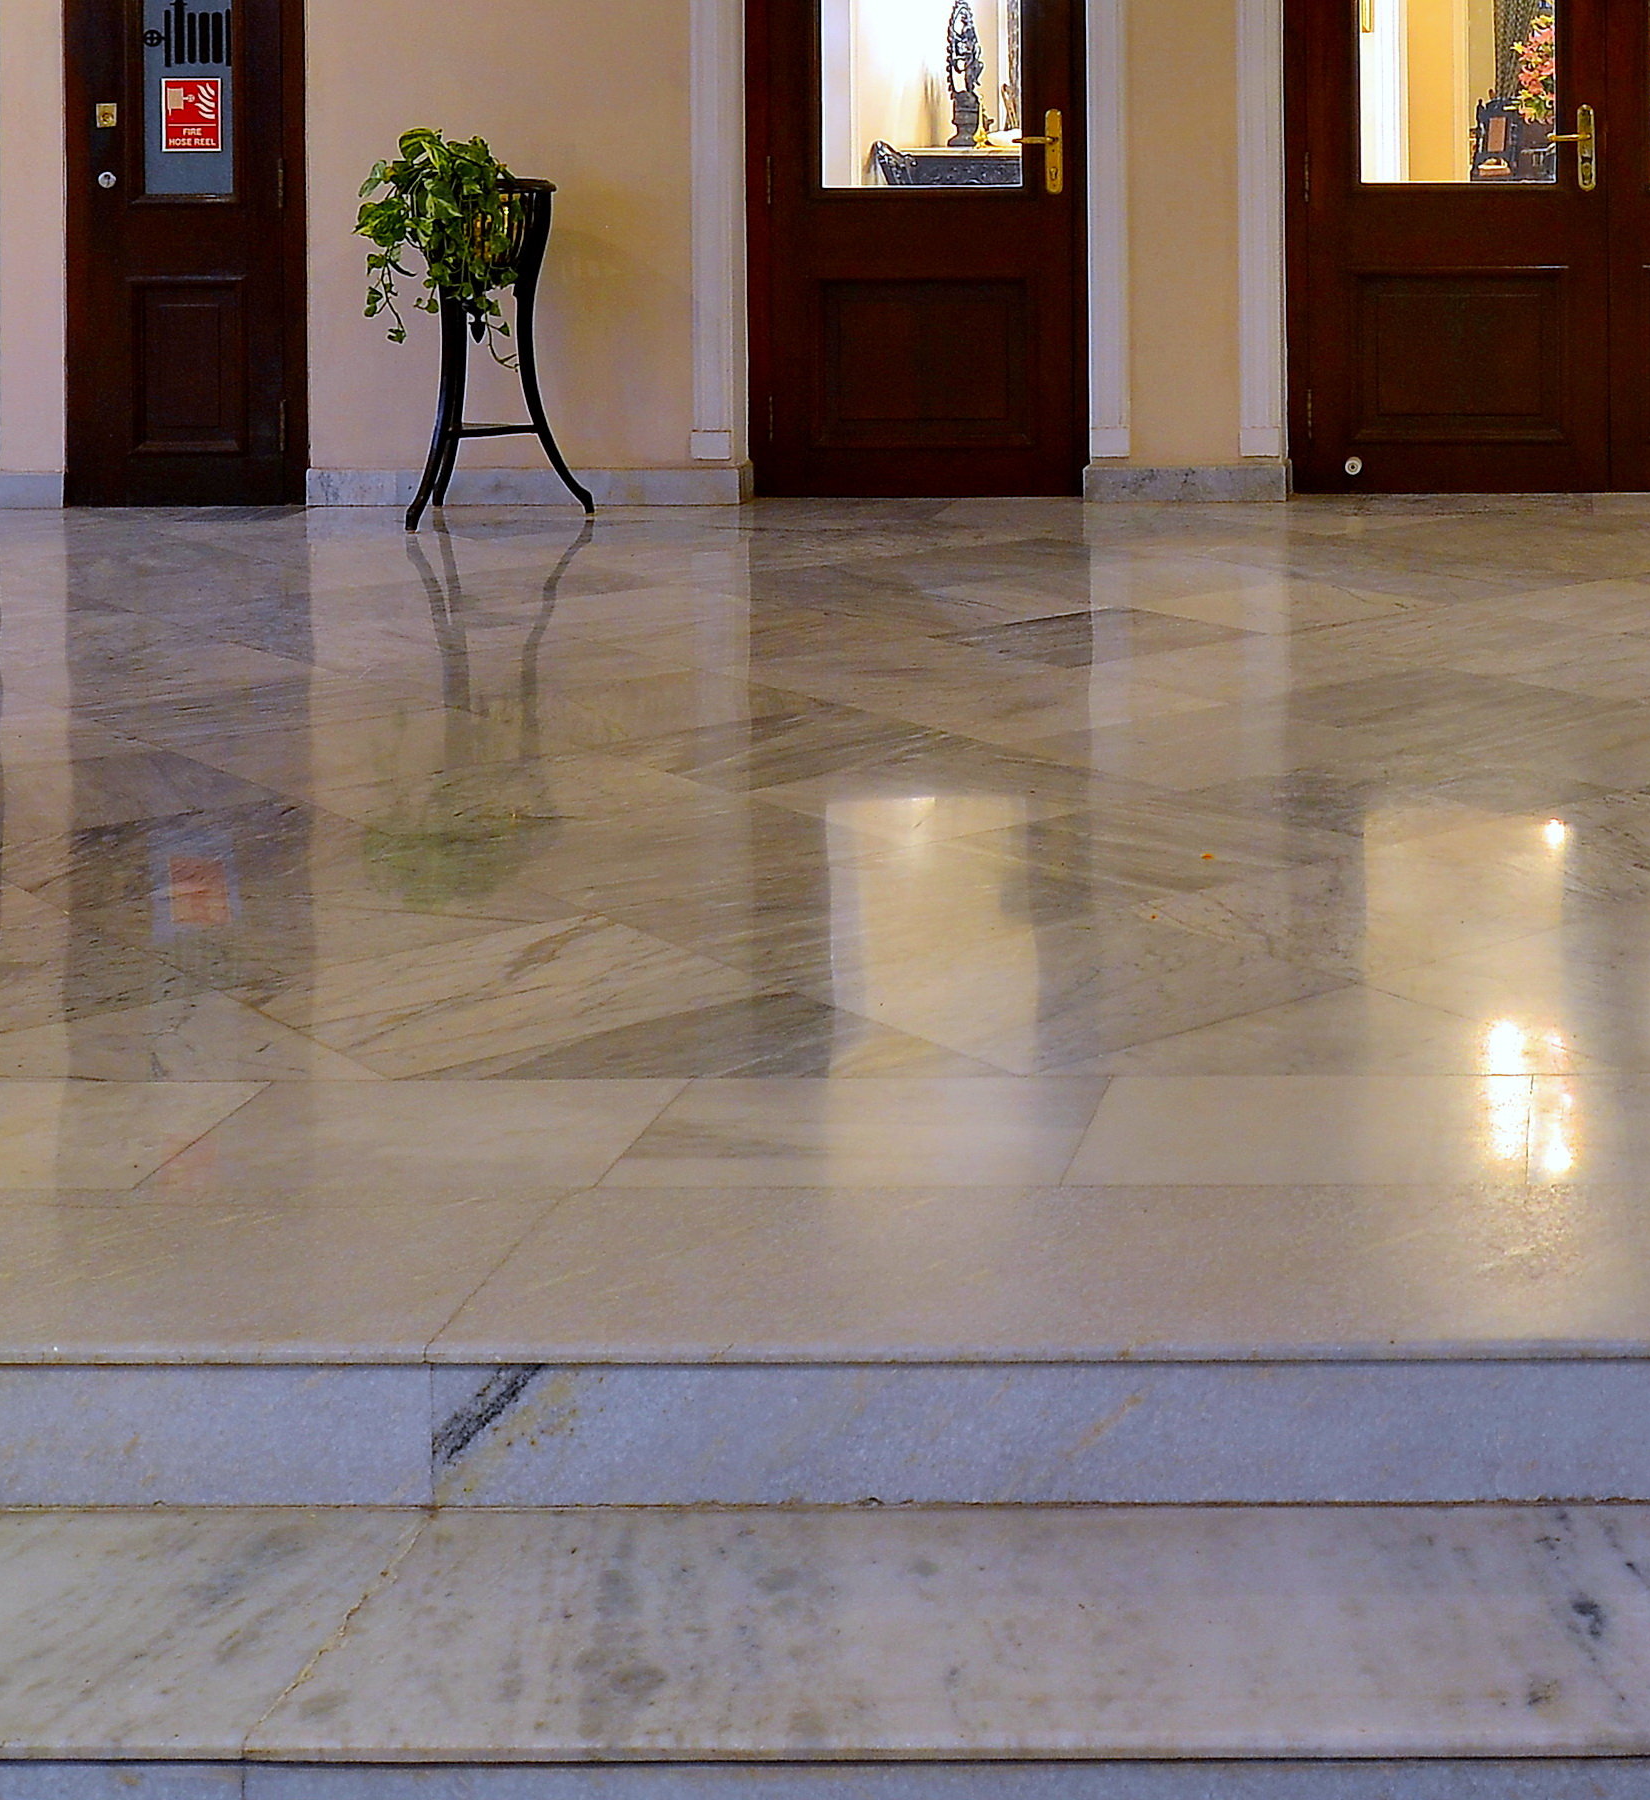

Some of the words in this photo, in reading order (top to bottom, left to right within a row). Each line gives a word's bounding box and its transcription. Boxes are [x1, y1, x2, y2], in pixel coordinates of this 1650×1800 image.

[182, 128, 202, 136] FIRE
[168, 138, 192, 146] HOSE
[193, 138, 216, 146] REEL
